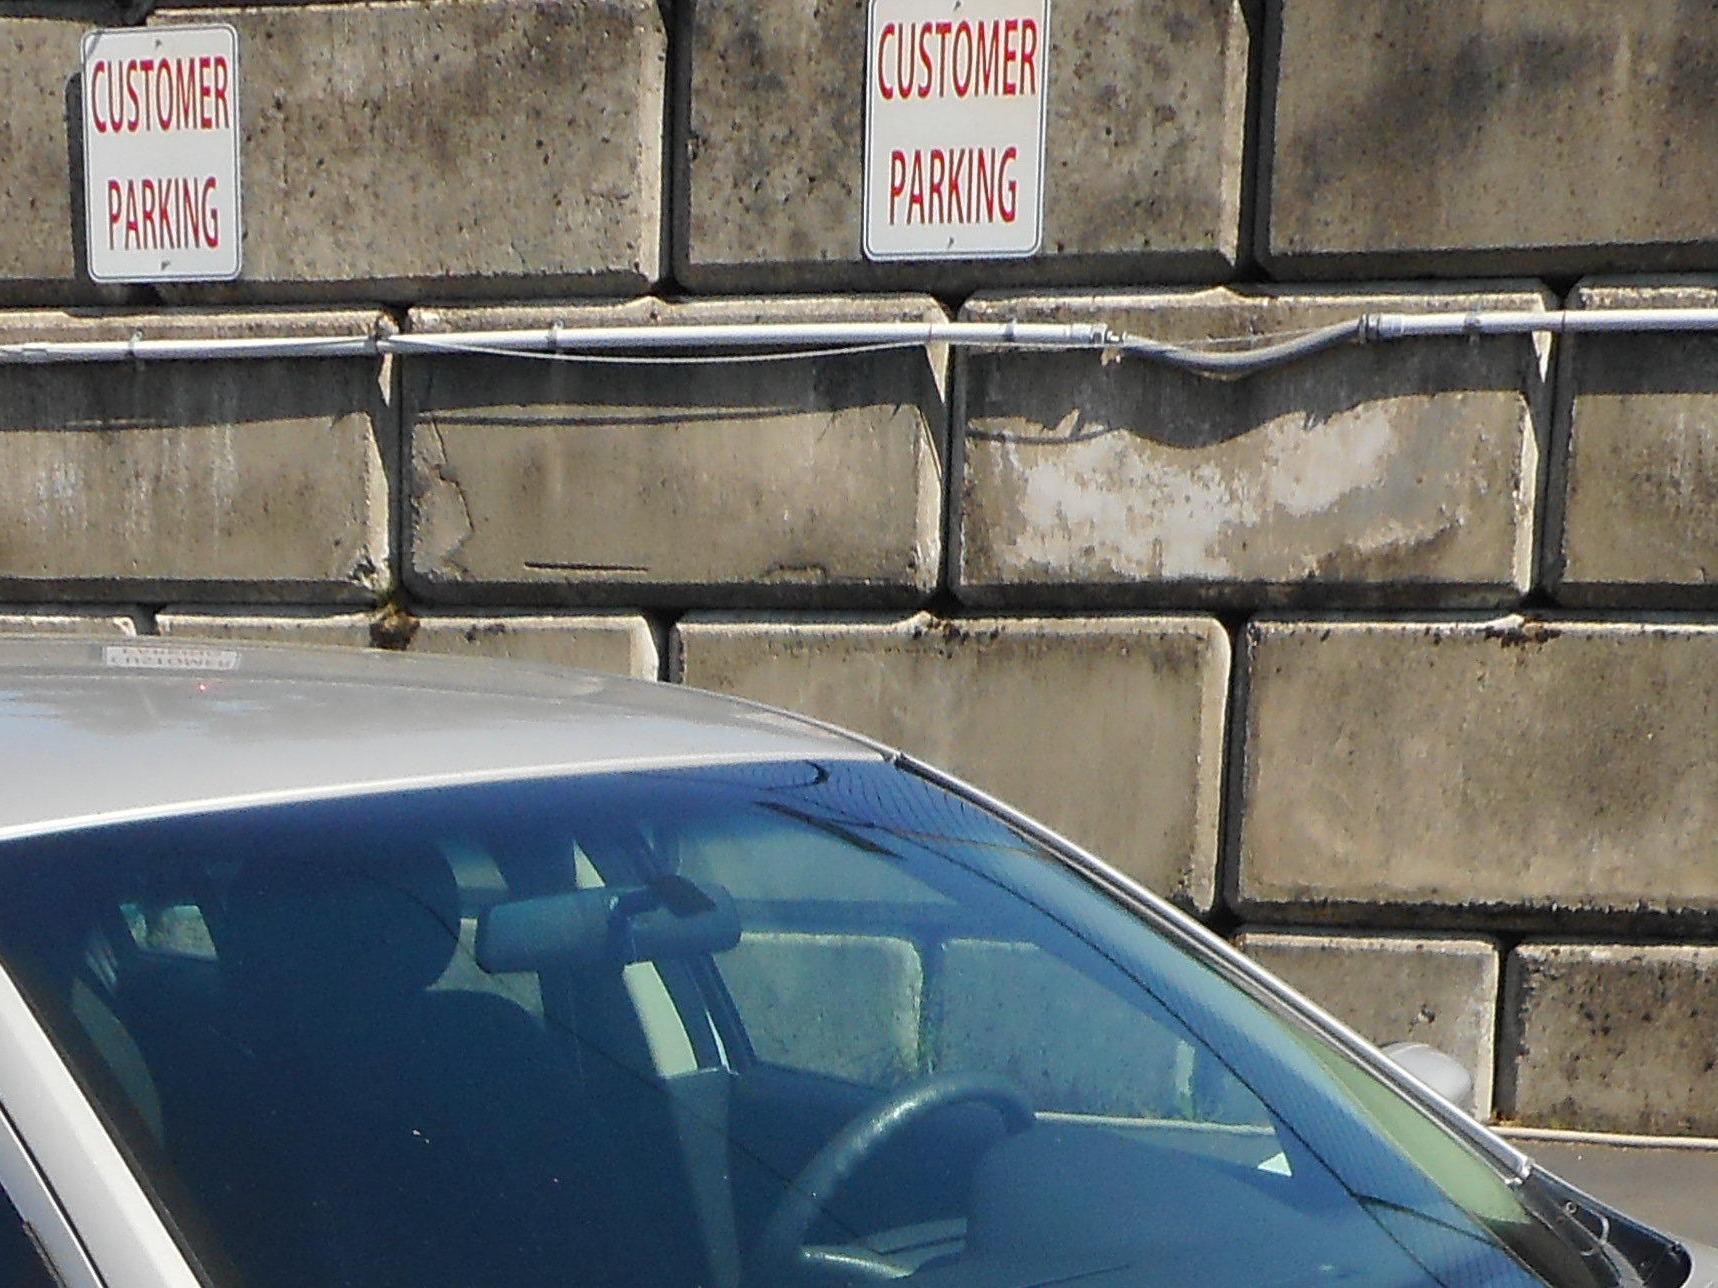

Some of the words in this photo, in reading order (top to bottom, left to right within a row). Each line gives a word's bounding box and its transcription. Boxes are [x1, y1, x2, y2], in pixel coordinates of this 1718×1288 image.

[91, 56, 230, 133] CUSTOMER
[878, 18, 1038, 100] CUSTOMER
[107, 176, 219, 250] PARKING
[888, 146, 1017, 226] PARKING
